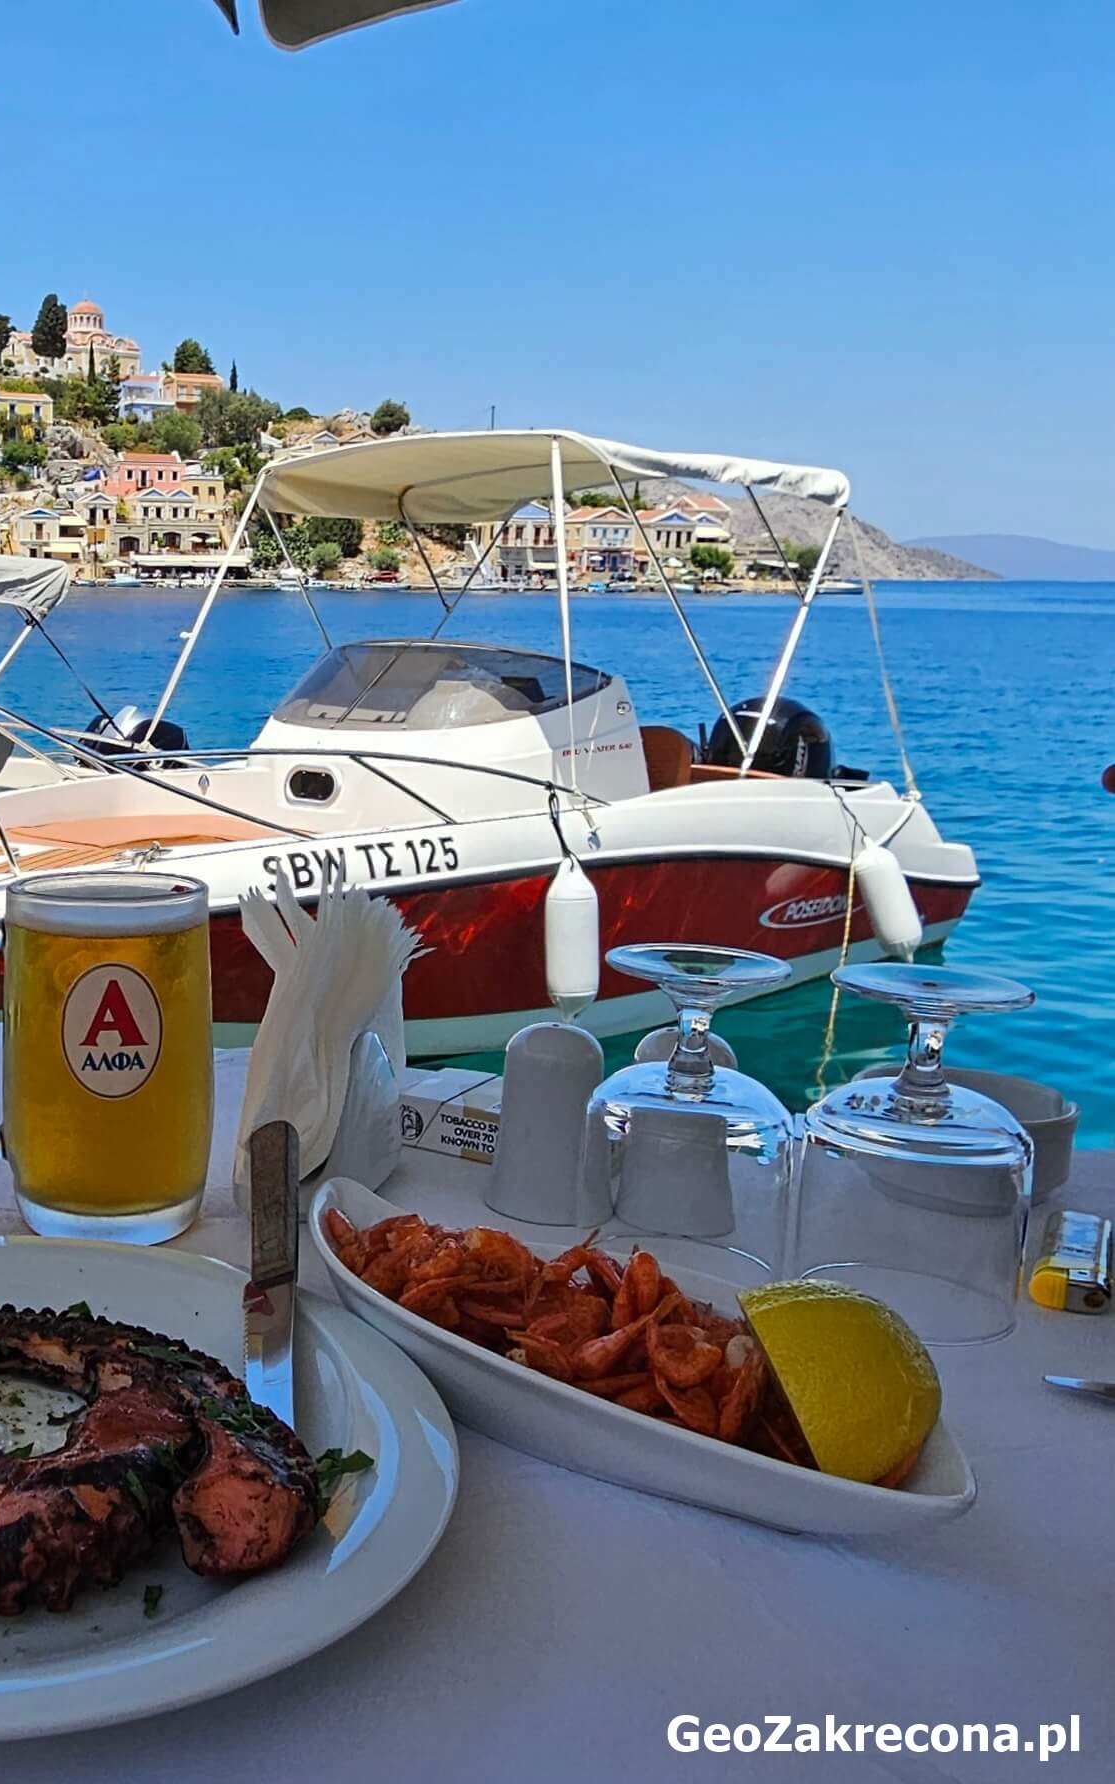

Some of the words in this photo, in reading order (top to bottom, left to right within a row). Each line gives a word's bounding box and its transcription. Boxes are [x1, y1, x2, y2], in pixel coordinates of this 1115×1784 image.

[262, 847, 348, 892] SBW
[355, 841, 402, 880] ΤΣ
[404, 836, 459, 876] 125
[81, 1050, 146, 1072] ΑΛΦΑ
[440, 1113, 487, 1131] TOBACCO
[440, 1134, 480, 1151] KNOWN
[481, 1142, 495, 1154] TO
[454, 1127, 481, 1141] OVER
[482, 1132, 495, 1144] 70
